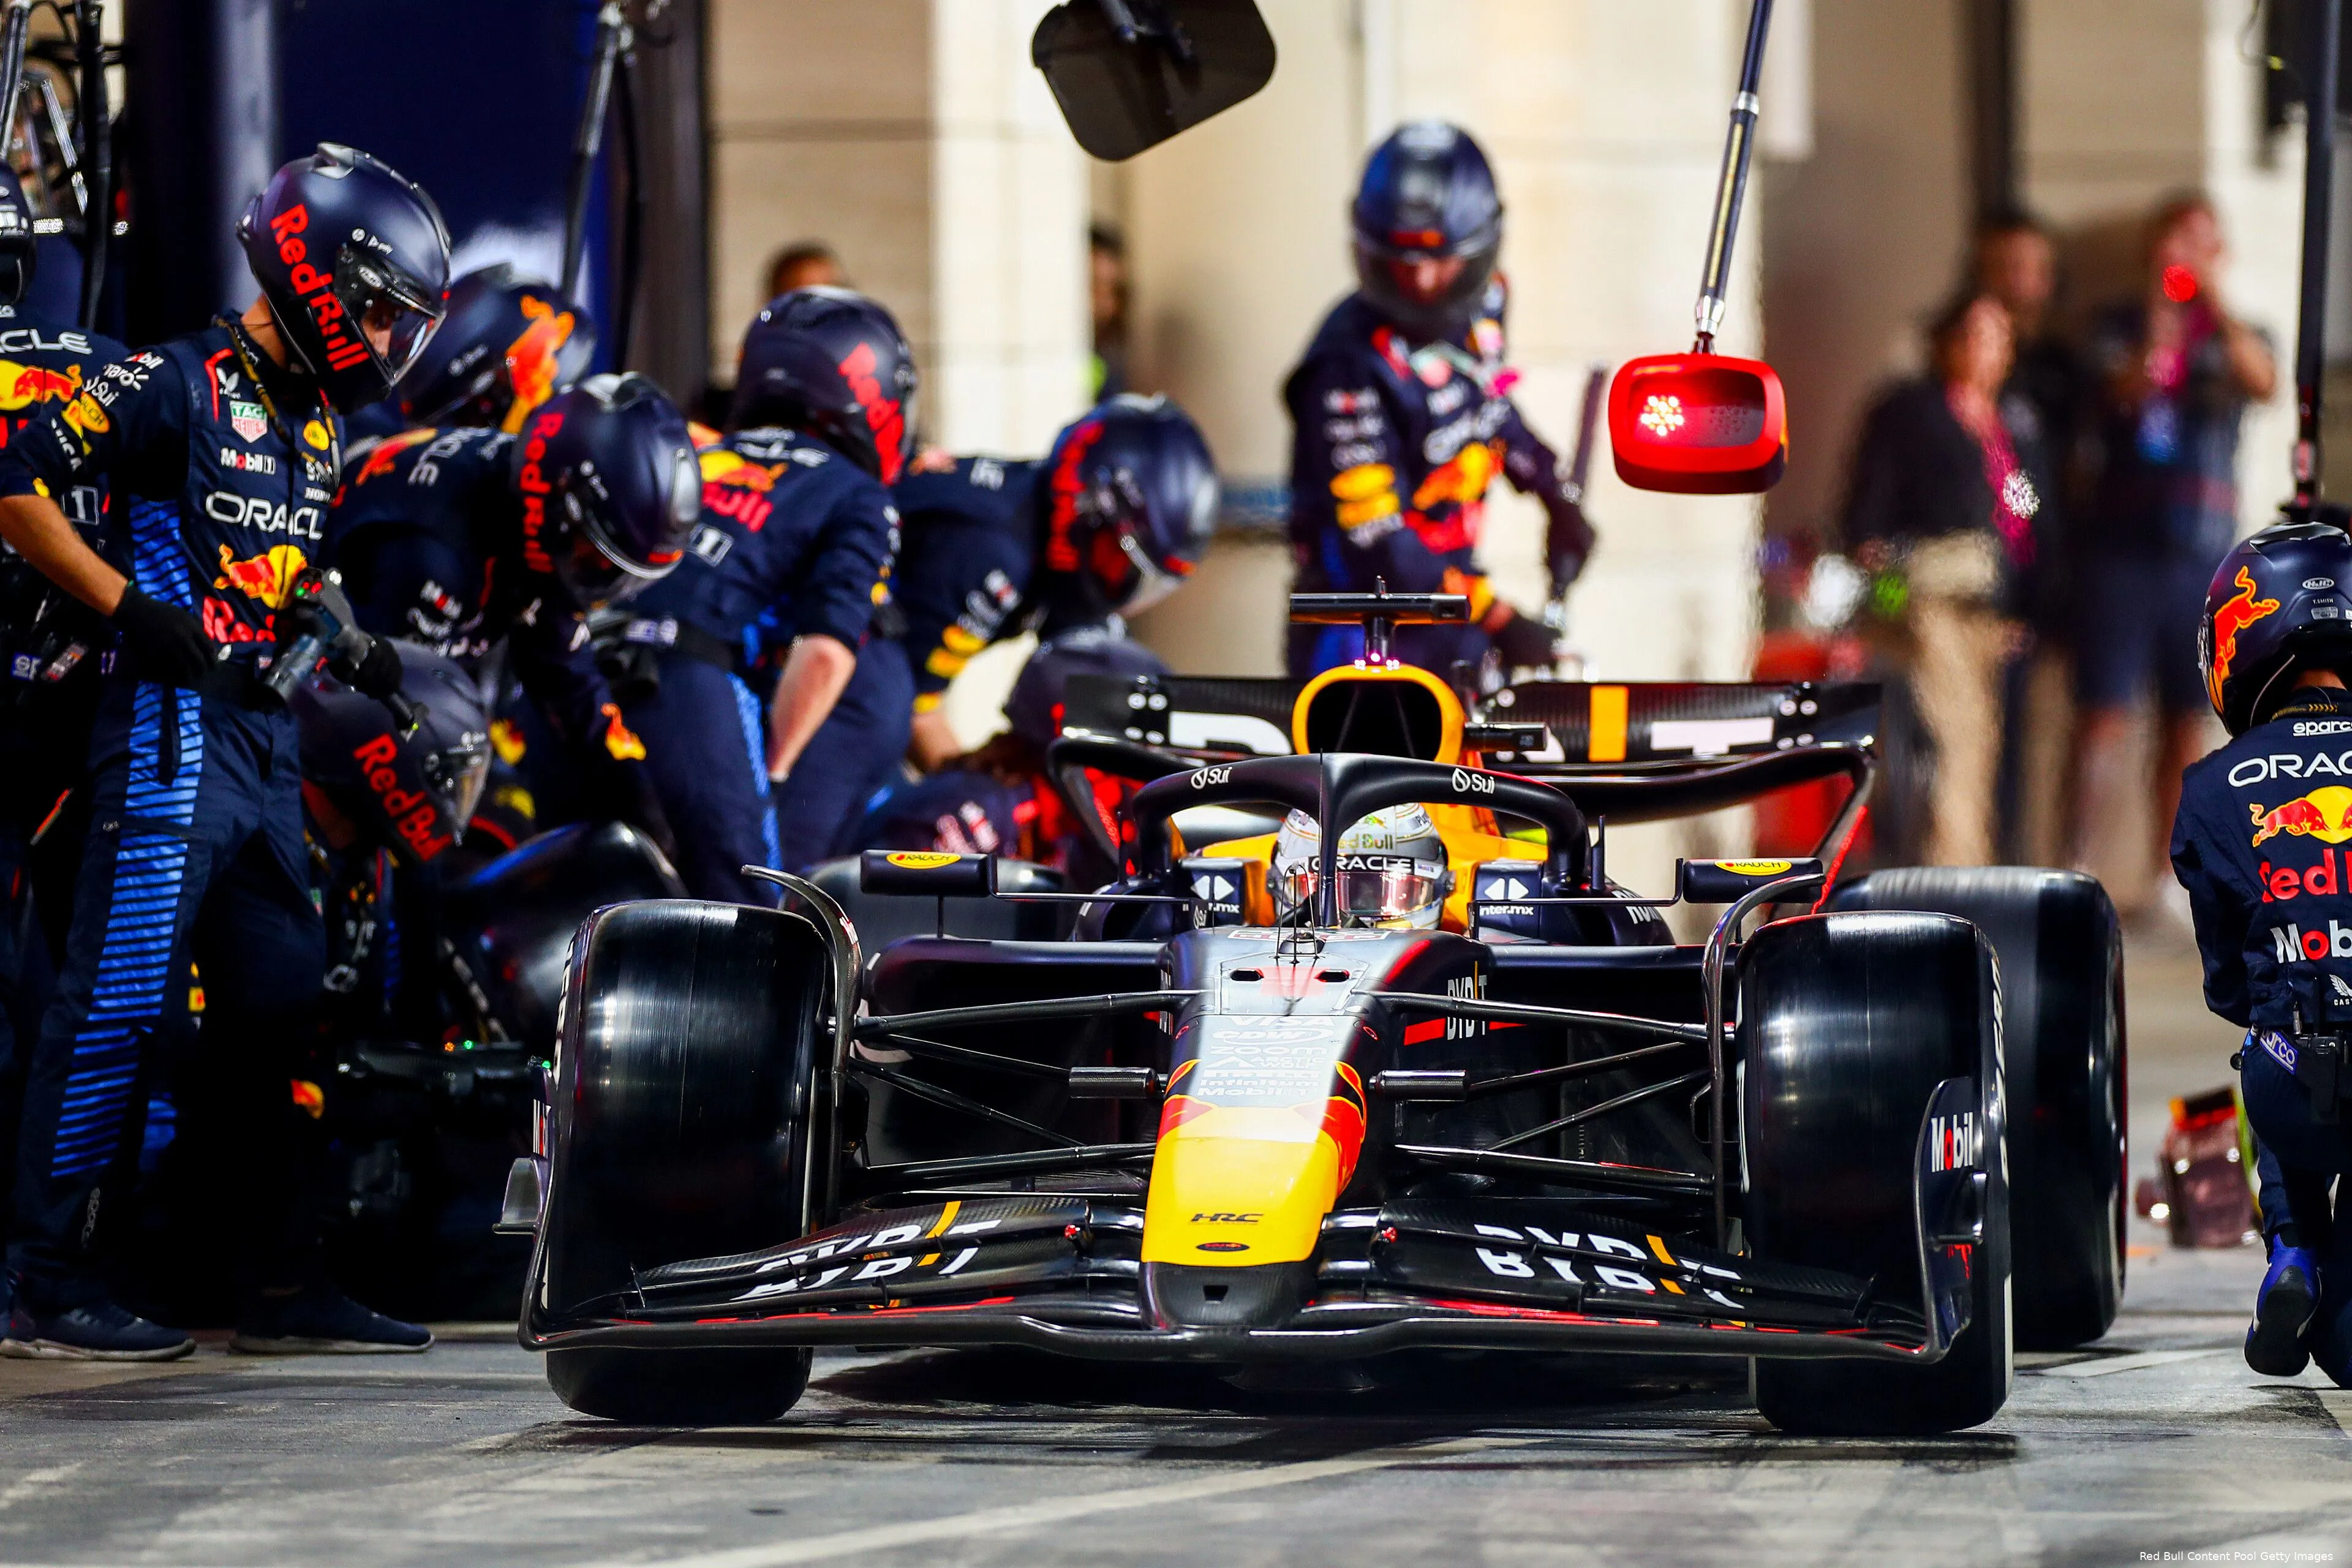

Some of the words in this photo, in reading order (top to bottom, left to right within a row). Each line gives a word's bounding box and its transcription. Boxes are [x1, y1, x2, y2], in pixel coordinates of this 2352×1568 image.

[270, 204, 333, 295] Red
[0, 329, 93, 355] CLE
[233, 405, 265, 419] TAG
[221, 447, 263, 472] Mobil
[2293, 720, 2352, 736] sparc
[353, 732, 426, 818] Red
[1207, 766, 1232, 785] Sui
[1471, 774, 1494, 794] Sui
[1338, 833, 1359, 849] ed
[1362, 834, 1393, 850] Bull
[1227, 1016, 1335, 1026] VISA
[1209, 1046, 1328, 1055] zoom
[1197, 1087, 1284, 1096] Mobil
[1931, 1112, 1973, 1173] Mobil
[1191, 1213, 1264, 1222] HRC
